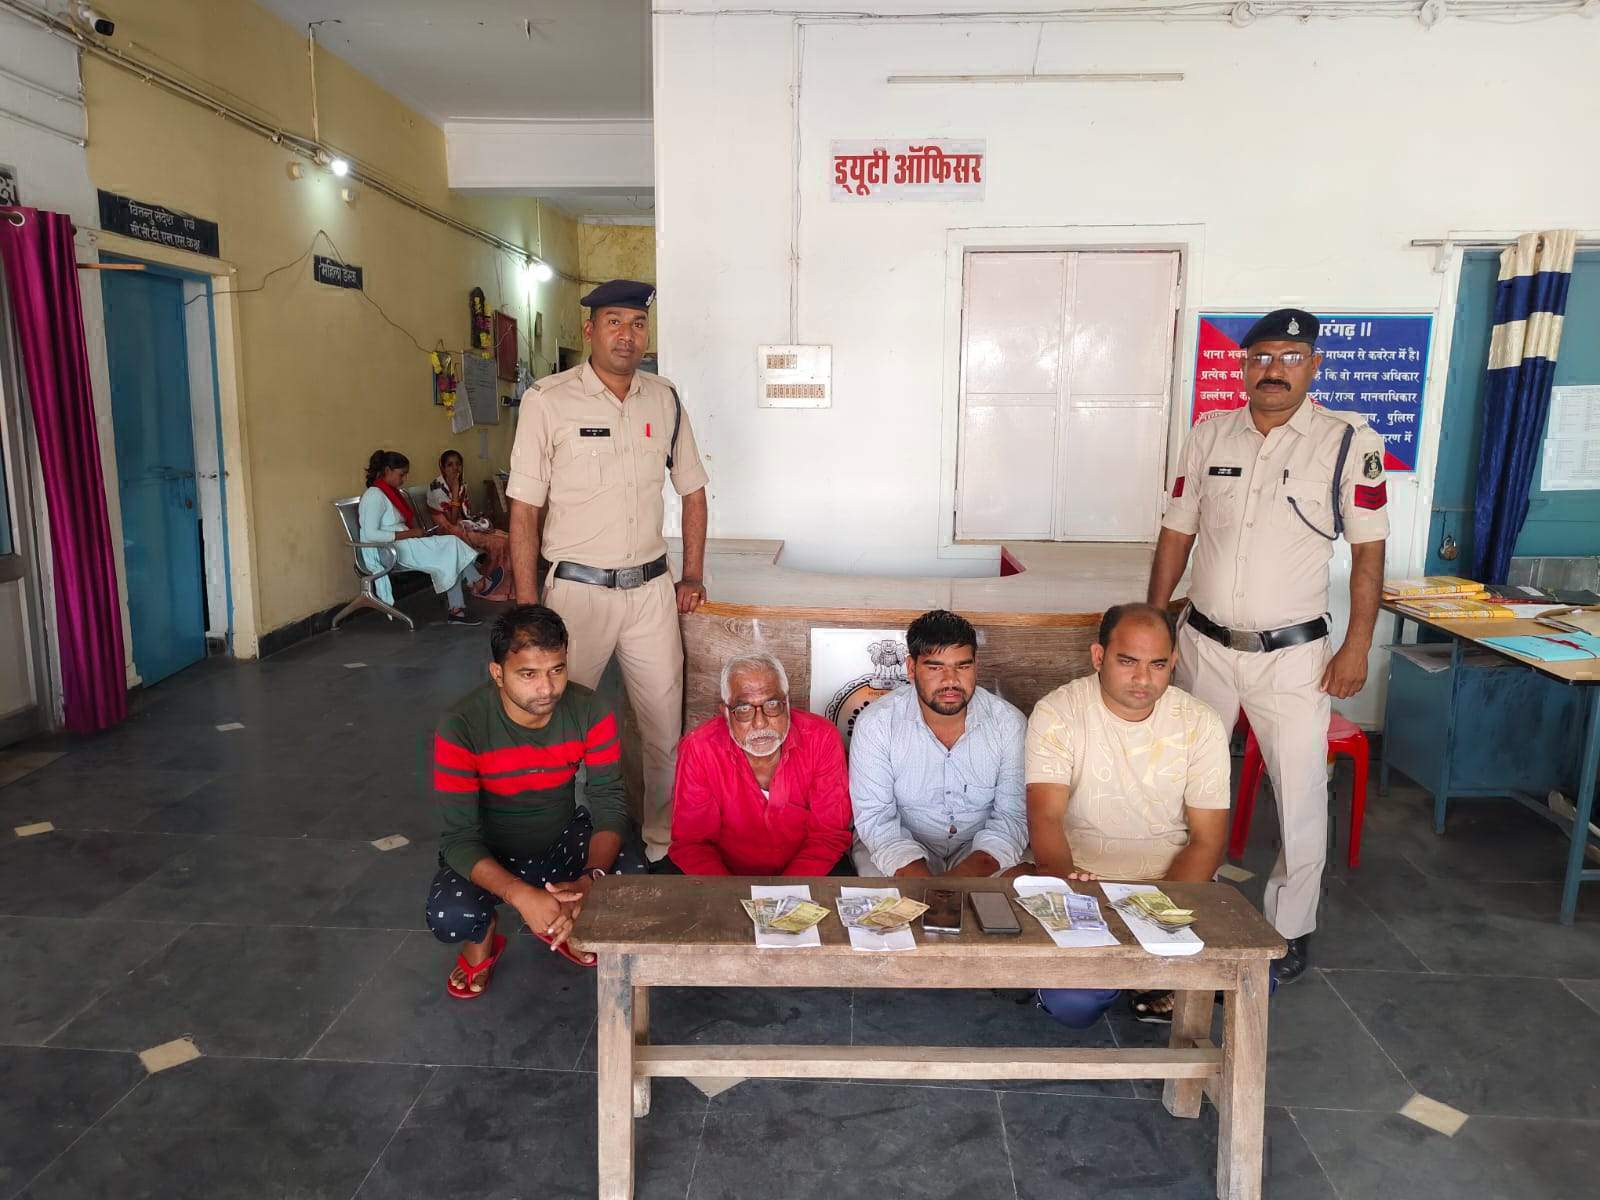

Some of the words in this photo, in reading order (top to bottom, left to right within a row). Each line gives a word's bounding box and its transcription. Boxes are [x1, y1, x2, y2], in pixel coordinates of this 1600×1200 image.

[834, 147, 890, 196] ड्यूटी
[894, 145, 983, 184] ऑफिसर
[1203, 350, 1226, 360] थाना
[1326, 350, 1356, 361] माध्यम
[1357, 347, 1367, 361] से
[1367, 347, 1397, 362] कवरेज
[1398, 346, 1407, 361] में
[1200, 367, 1228, 381] प्रत्येक
[1325, 368, 1337, 382] कि
[1340, 368, 1351, 381] वो
[1354, 371, 1380, 381] मानव
[1381, 368, 1420, 383] अधिकार
[1360, 389, 1418, 403] मानवाधिकार
[1386, 410, 1416, 426] पुलिस
[1403, 430, 1413, 444] में
